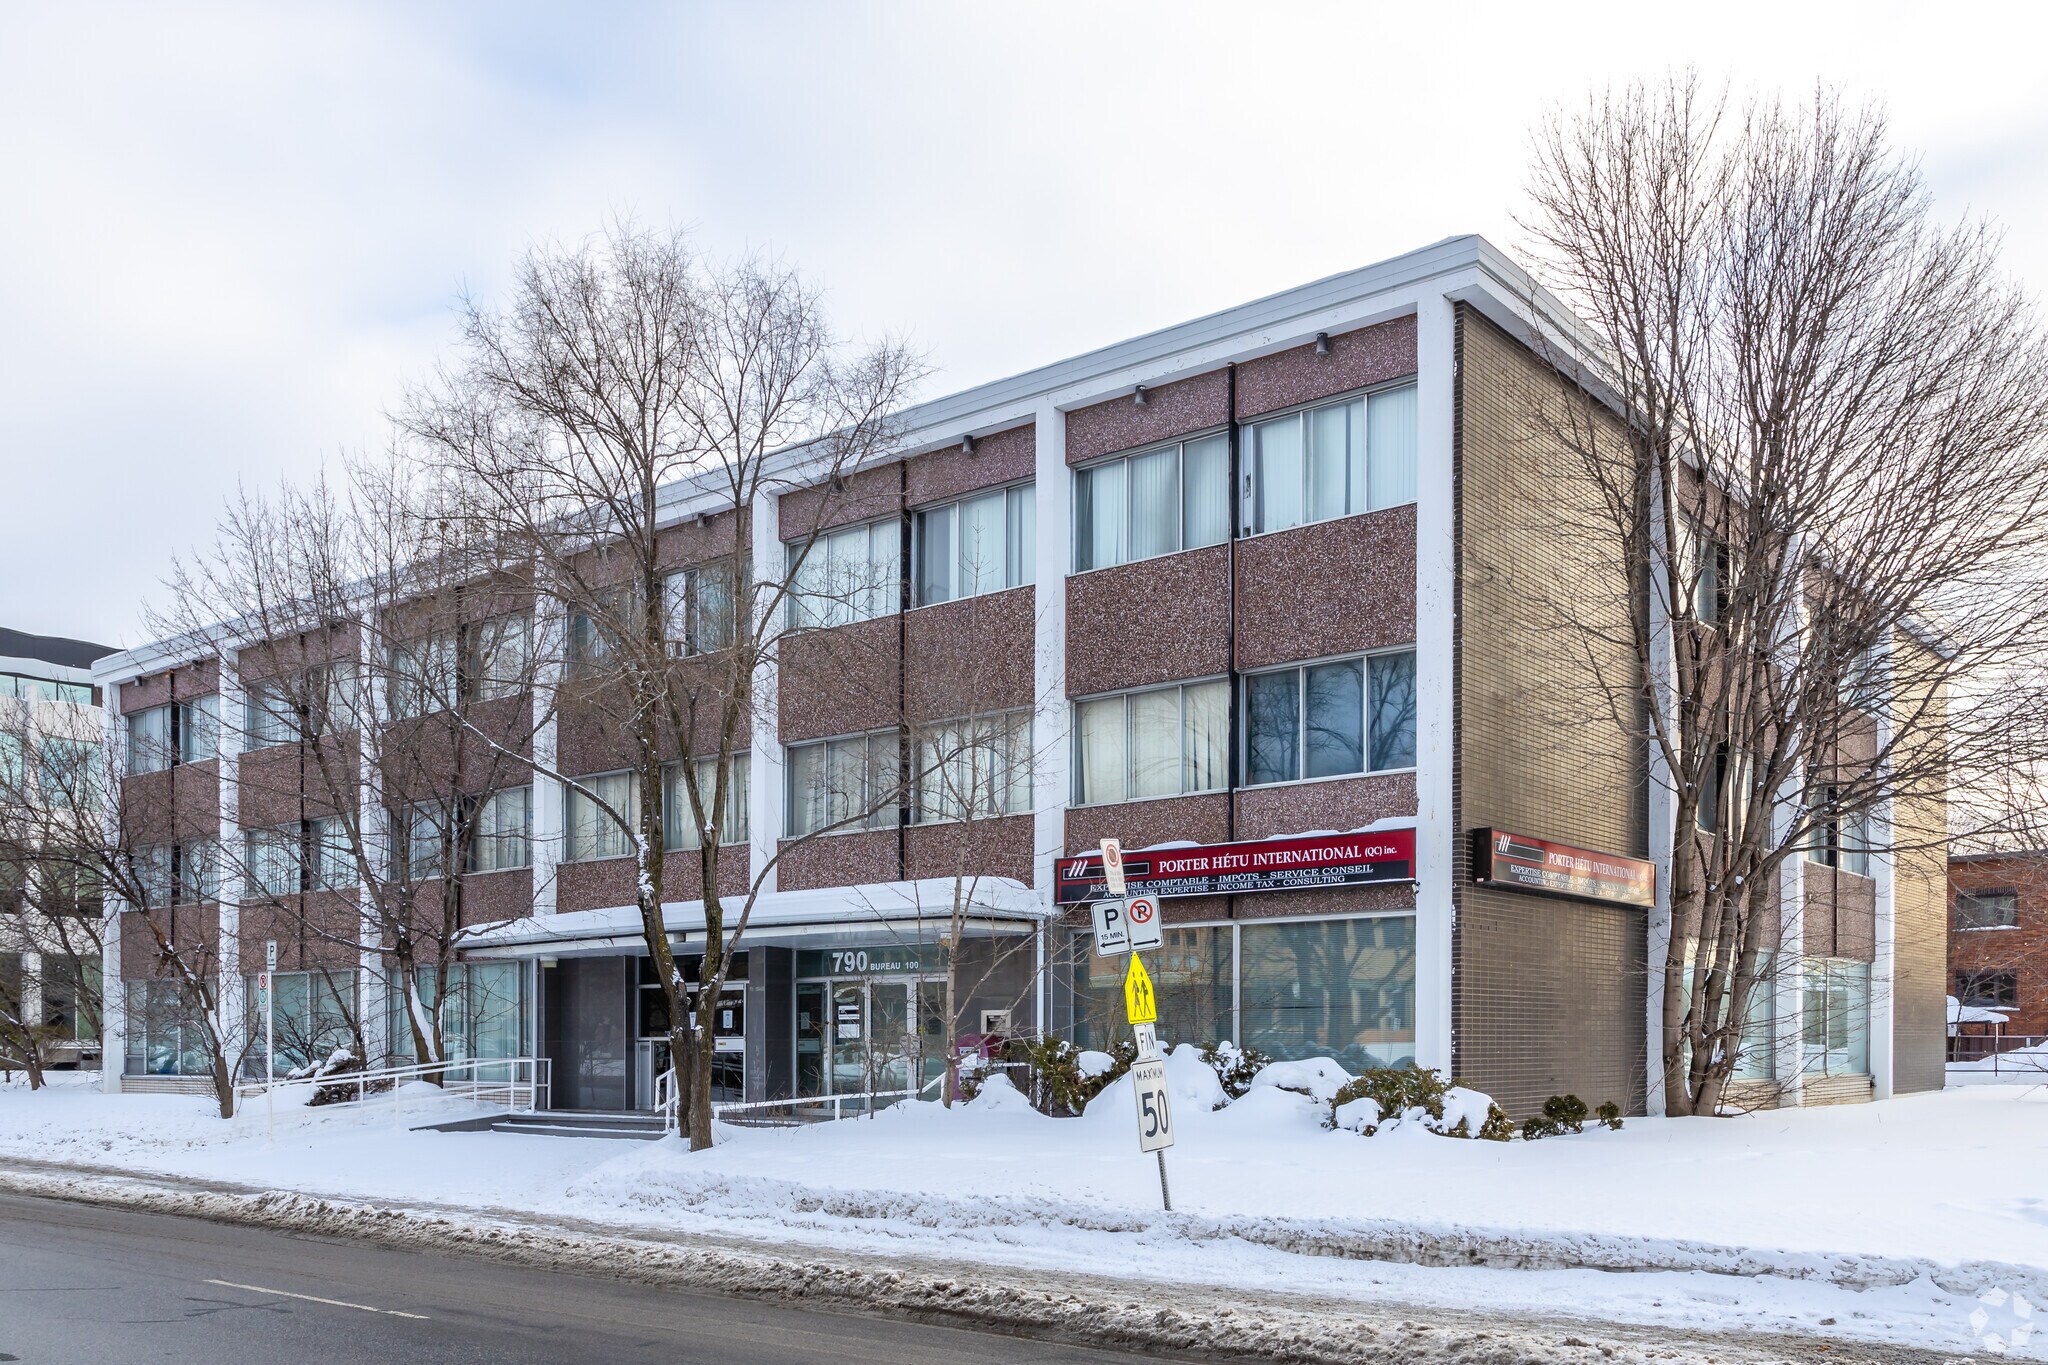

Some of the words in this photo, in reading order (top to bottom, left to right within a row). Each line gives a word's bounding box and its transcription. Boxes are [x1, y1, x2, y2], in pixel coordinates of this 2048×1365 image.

[1159, 858, 1209, 873] PORTER
[1212, 853, 1249, 869] HÉTU
[1253, 845, 1361, 866] INTERNATIONAL
[1365, 846, 1382, 858] (QC)
[1384, 845, 1397, 855] inc.
[1549, 852, 1574, 869] PORTER
[1575, 856, 1592, 872] HÉTU
[1593, 861, 1636, 880] INTERNATIONAL
[1090, 881, 1144, 891] EXPISE
[1146, 876, 1209, 888] COMPTABLE
[1219, 872, 1259, 883] IMPÔTS
[1270, 868, 1319, 878] SERVICE
[1322, 864, 1373, 875] CONSEIL
[1510, 864, 1541, 877] EXPERTISE
[1103, 888, 1158, 898] ACCUNTING
[1161, 884, 1209, 895] EXPERTISE
[1217, 881, 1254, 891] INCOME
[1255, 879, 1275, 888] TAX
[1283, 875, 1345, 886] CONSULTING
[1104, 908, 1118, 930] P
[1101, 933, 1109, 941] 15
[270, 945, 274, 957] P
[832, 951, 868, 973] 790
[870, 962, 901, 971] BUREAU
[905, 960, 919, 969] 100
[1139, 1030, 1156, 1051] FIN
[1136, 1067, 1164, 1081] MAXMM
[1141, 1089, 1169, 1138] 50
